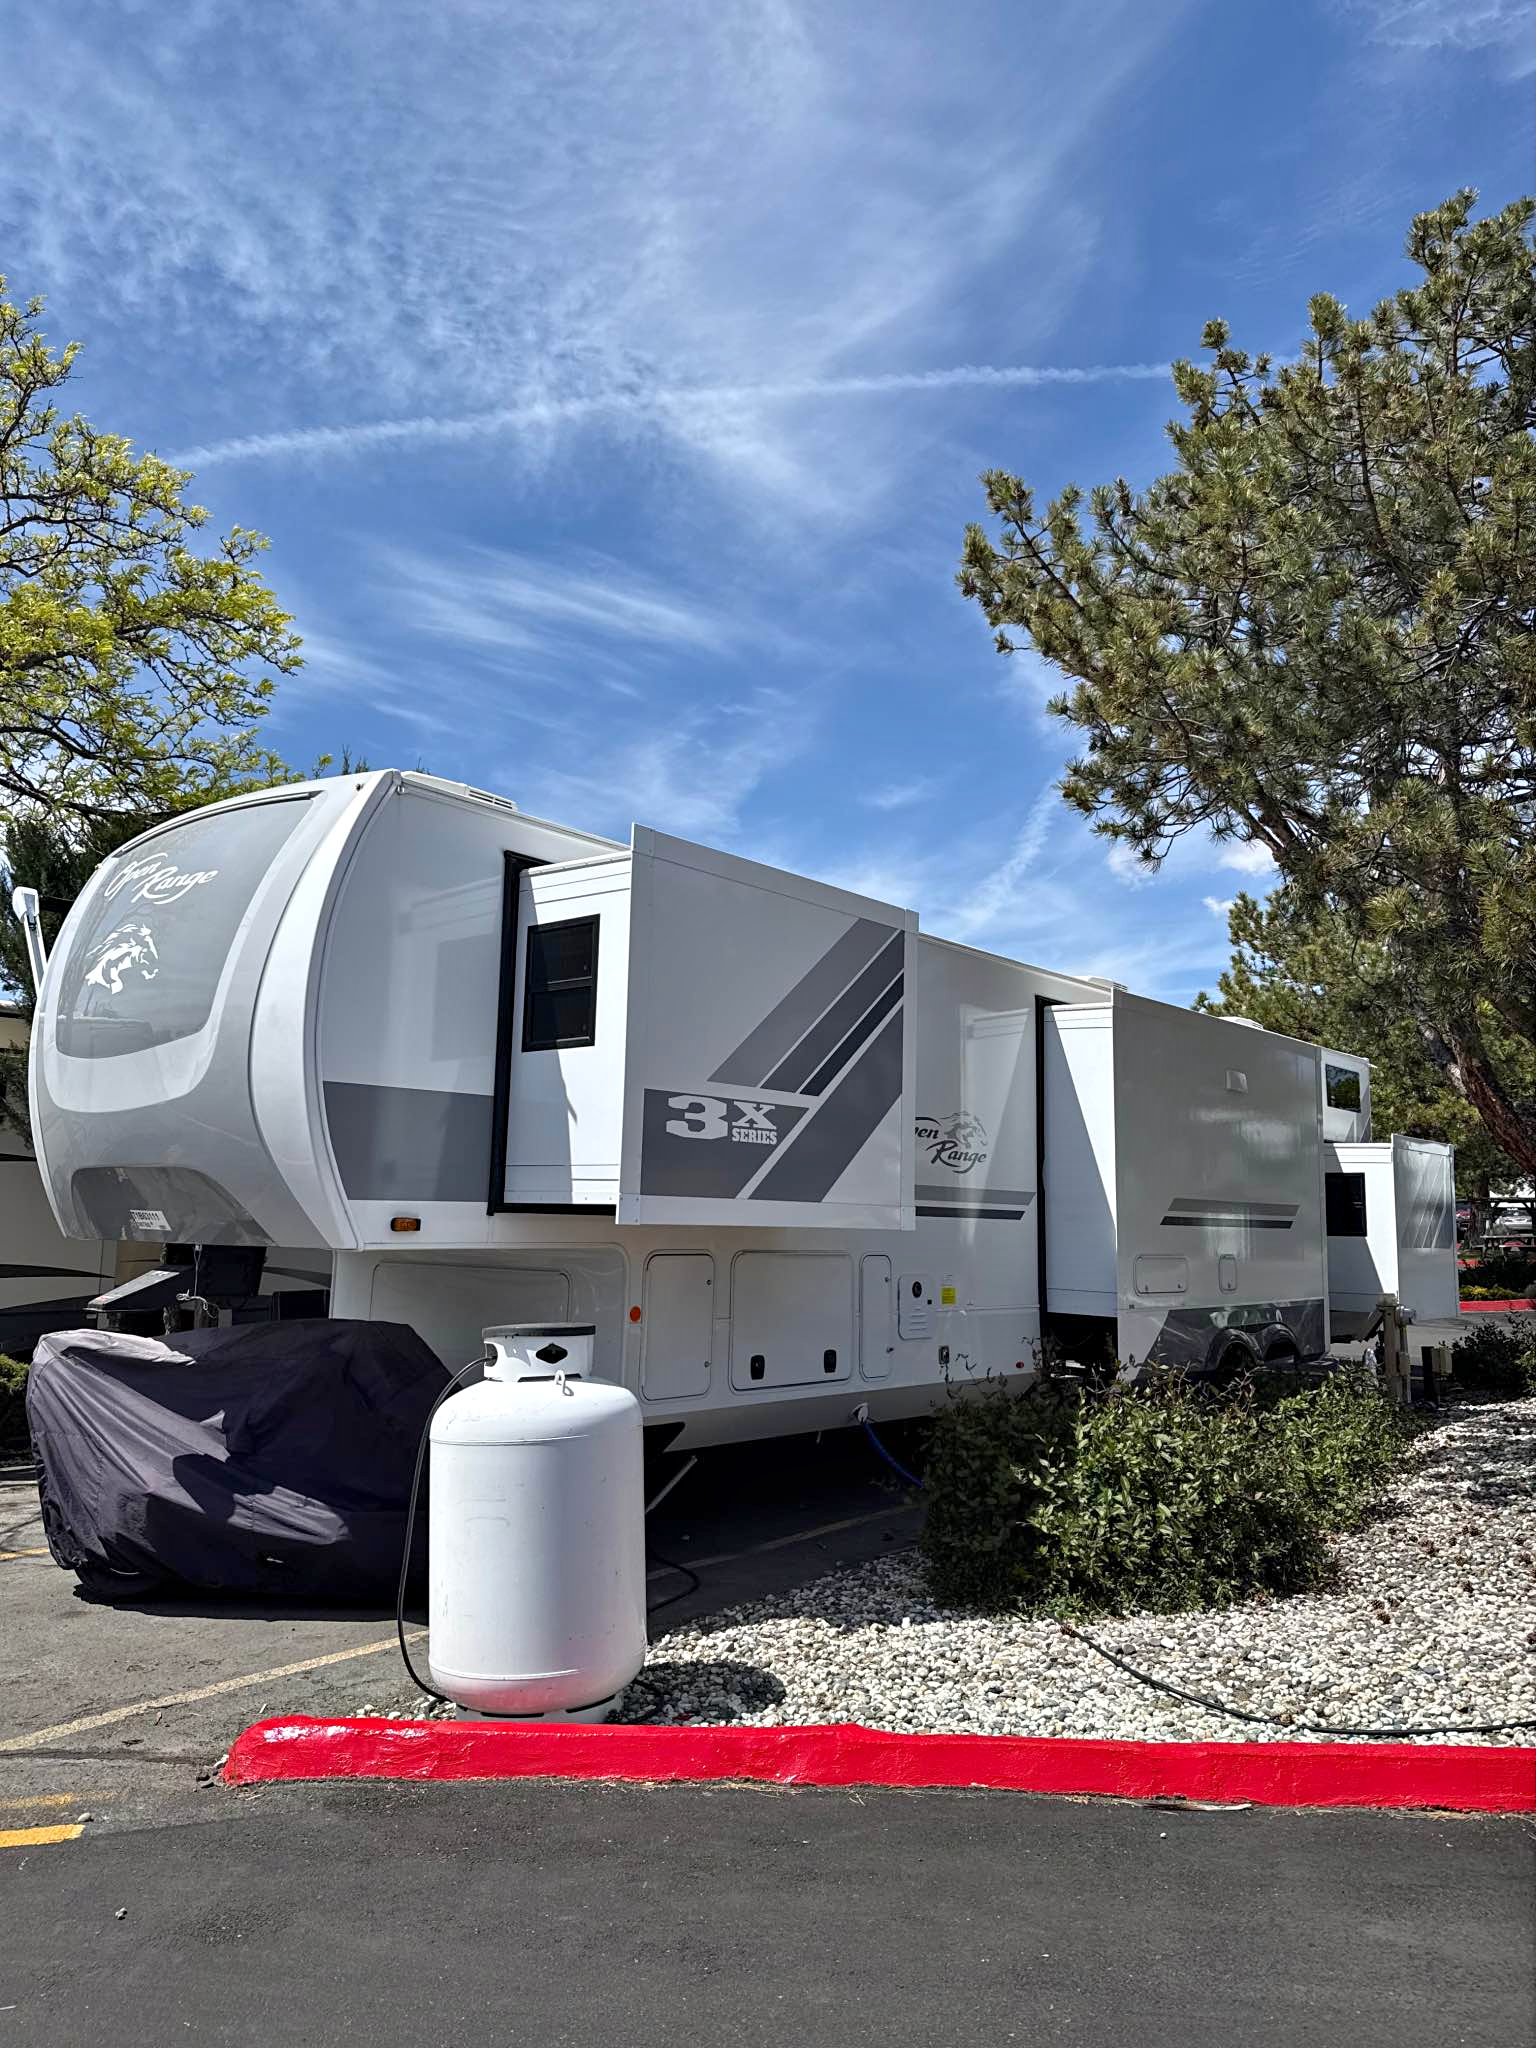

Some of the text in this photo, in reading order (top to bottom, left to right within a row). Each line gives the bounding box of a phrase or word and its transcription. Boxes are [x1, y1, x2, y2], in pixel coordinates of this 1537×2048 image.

[131, 866, 218, 904] Range
[732, 1128, 777, 1144] SERIES
[926, 1140, 987, 1173] Range
